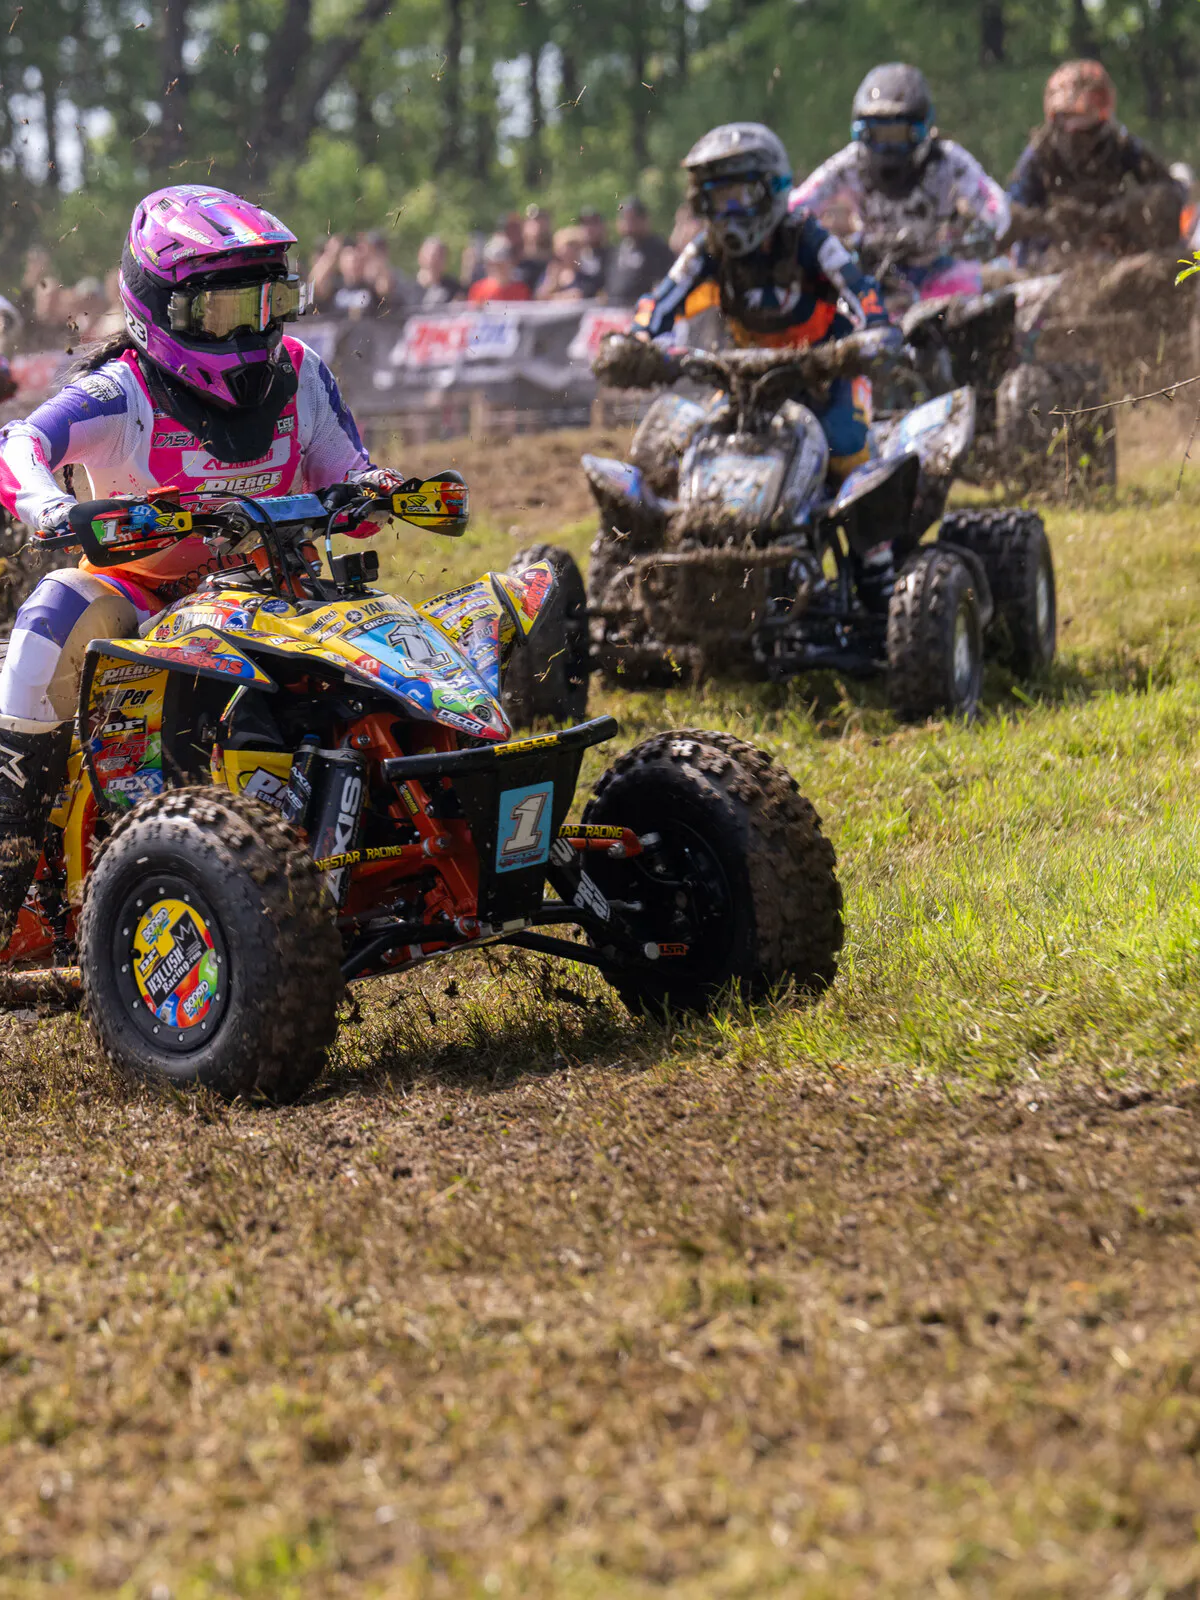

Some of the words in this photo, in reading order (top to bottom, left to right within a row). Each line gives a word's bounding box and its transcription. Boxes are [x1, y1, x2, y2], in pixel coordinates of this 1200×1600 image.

[152, 432, 195, 448] DASA
[200, 472, 281, 498] PIERCE
[102, 520, 119, 543] 1
[304, 609, 338, 635] QuadTech
[144, 645, 244, 675] MAXXIS
[387, 623, 452, 671] 1
[100, 664, 162, 686] PIERCE
[103, 719, 144, 733] DP
[437, 708, 484, 731] CECCO
[291, 766, 312, 792] AXIS
[286, 787, 304, 810] XIS
[502, 792, 549, 856] 1
[585, 826, 623, 838] RACING
[315, 850, 361, 872] NESTAR
[366, 845, 402, 860] RACING
[148, 946, 185, 996] H3LLISH
